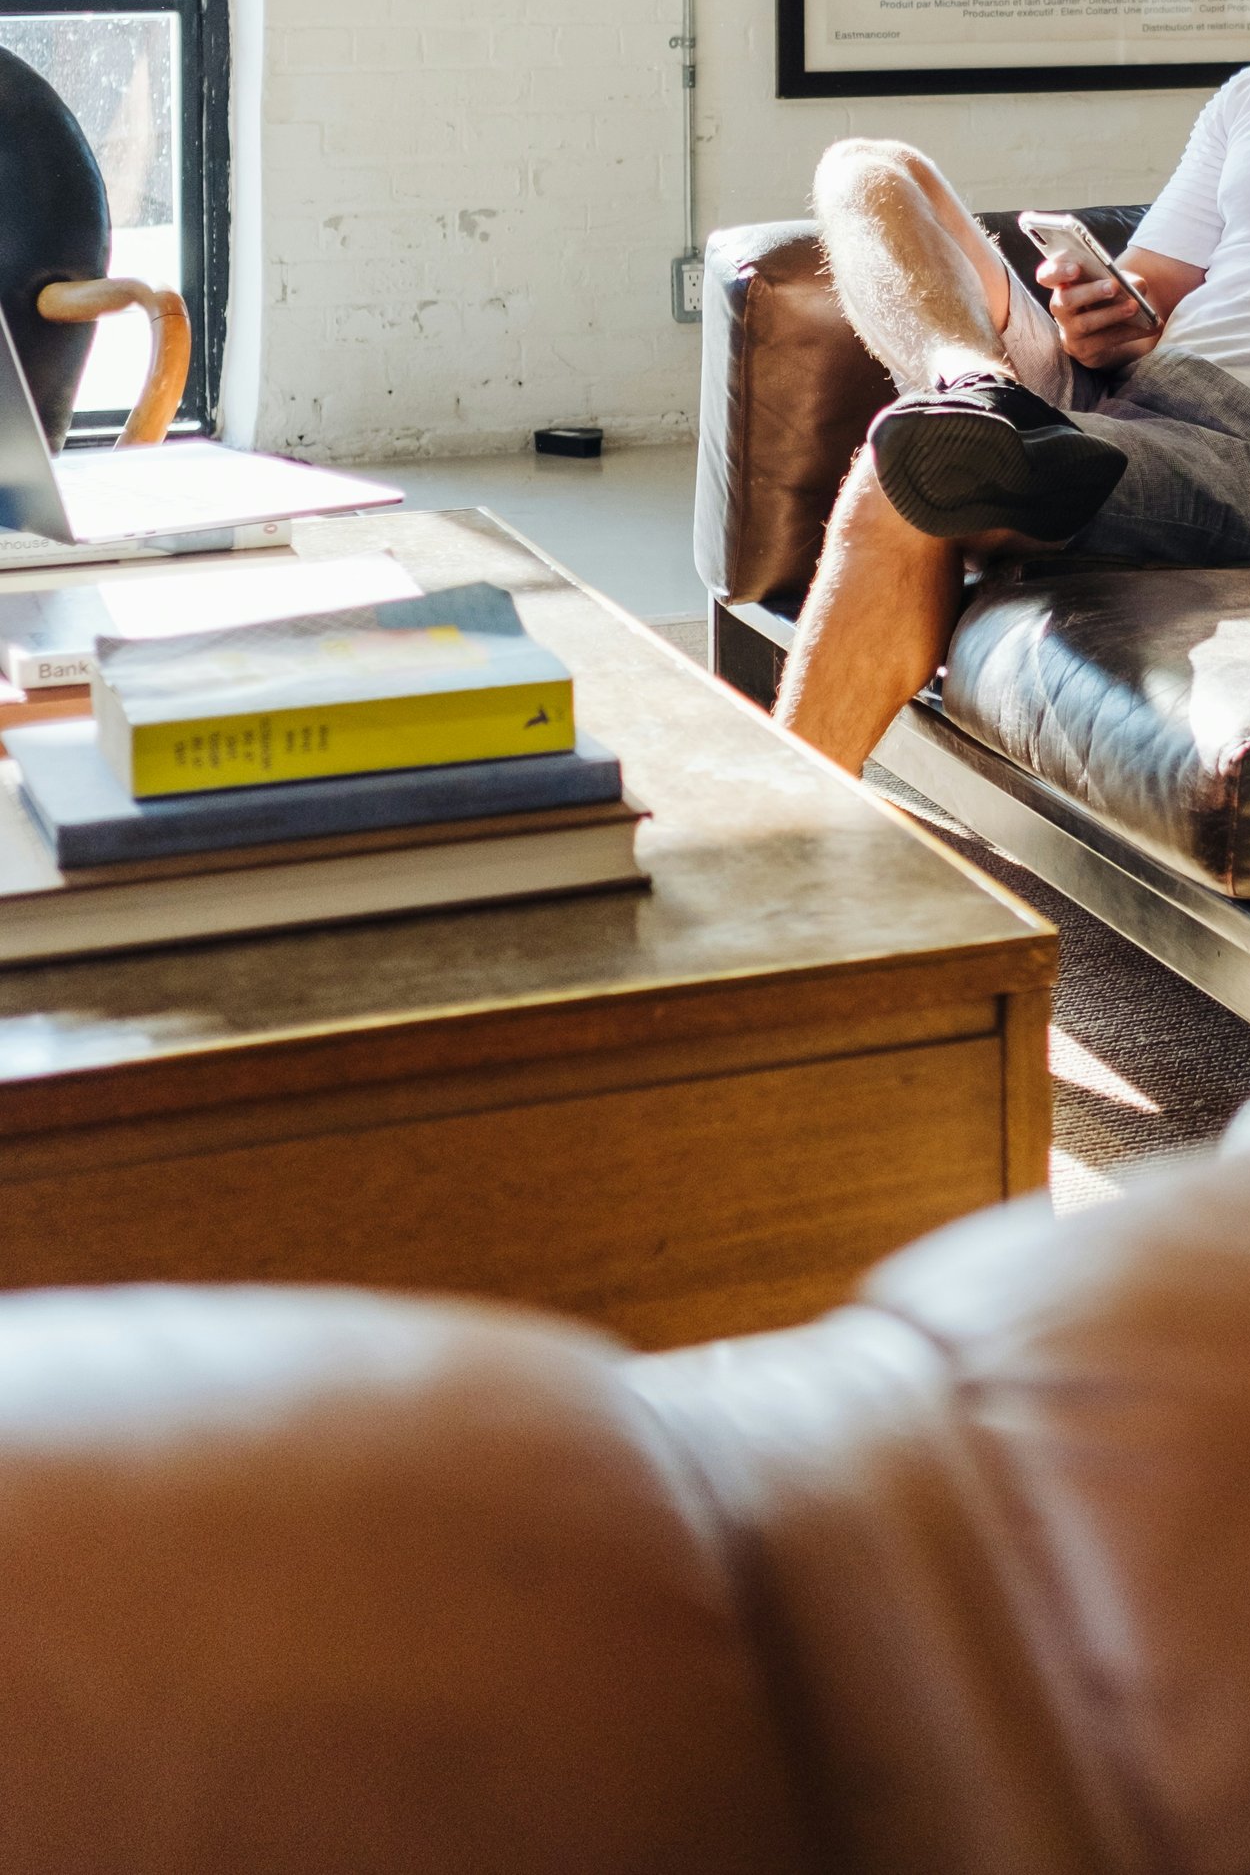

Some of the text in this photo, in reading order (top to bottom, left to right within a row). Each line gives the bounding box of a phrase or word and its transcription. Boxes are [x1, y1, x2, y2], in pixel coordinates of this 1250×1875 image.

[880, 0, 914, 9] Produit
[916, 1, 931, 11] par
[934, 0, 970, 8] Michael
[962, 8, 1014, 18] Producteur
[1017, 7, 1054, 17] exécutif
[1123, 5, 1142, 14] Une
[1143, 4, 1193, 16] production
[1199, 3, 1225, 14] Cupid
[1142, 22, 1193, 33] Distribution
[1196, 22, 1206, 31] et
[1207, 20, 1245, 31] relations
[834, 29, 901, 40] Eastmancolor
[38, 660, 90, 680] Bank
